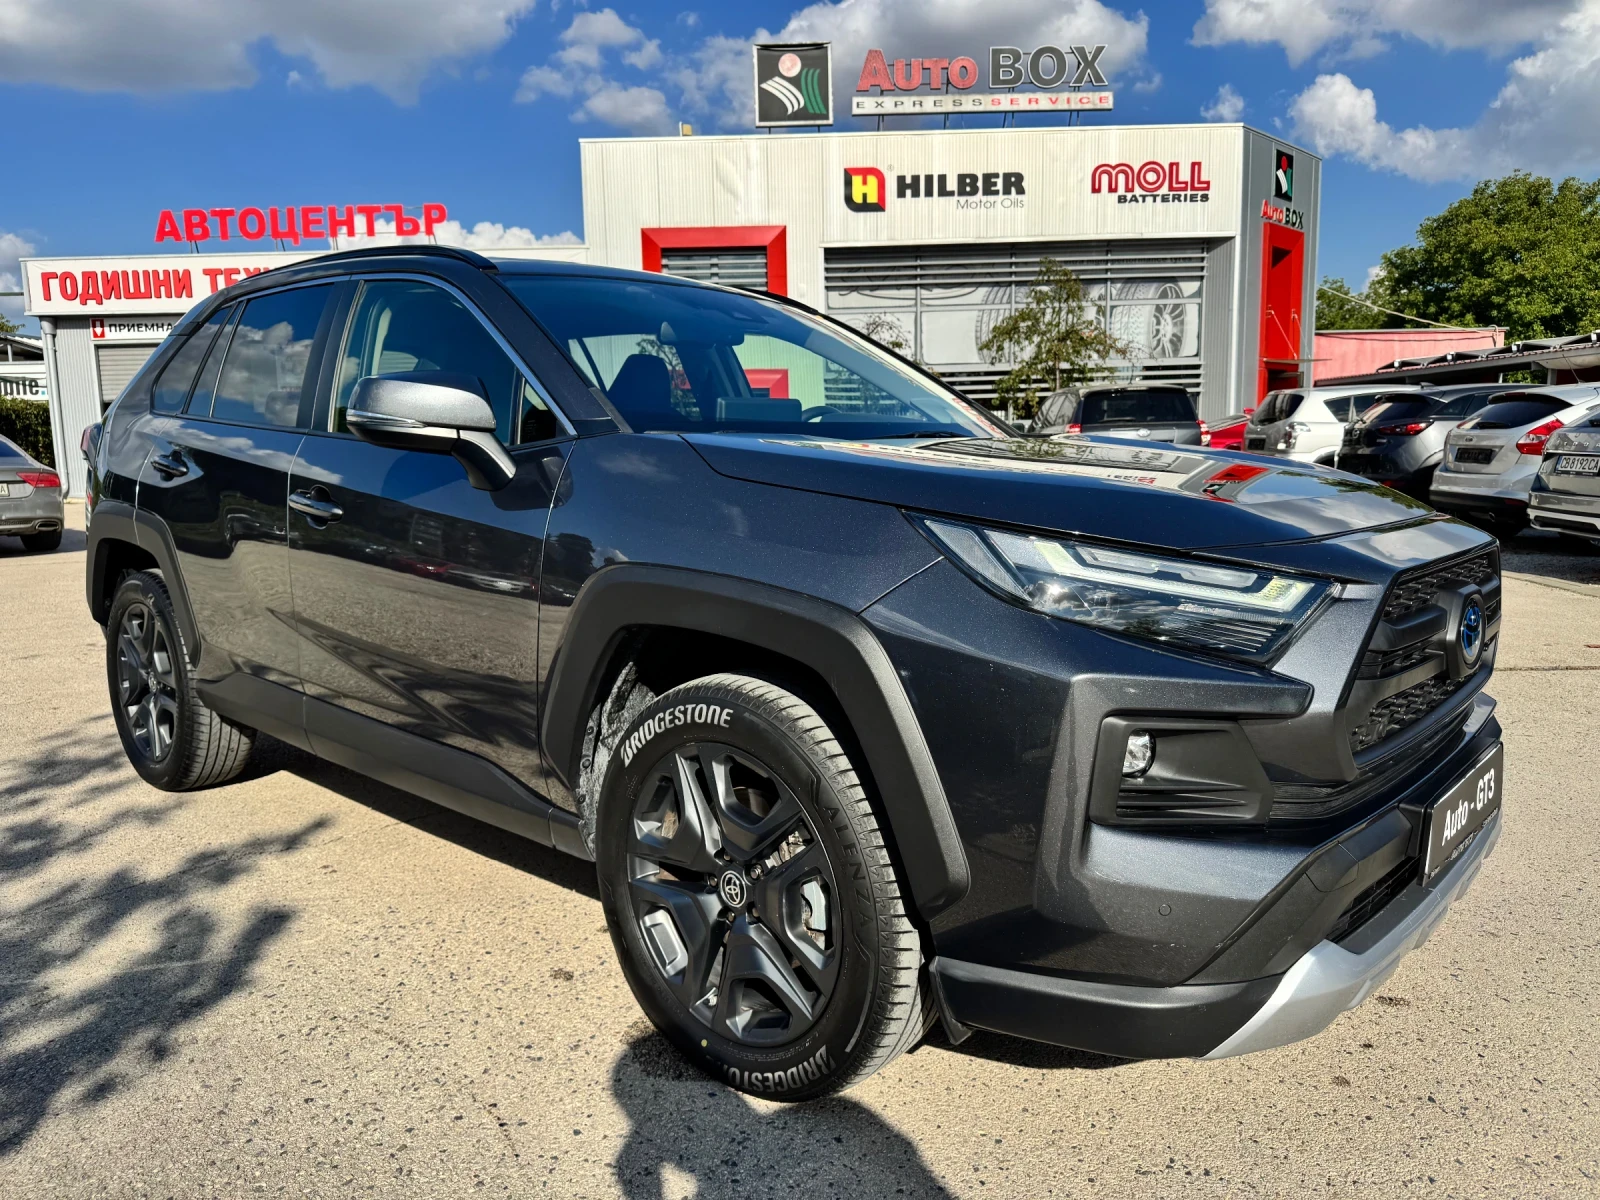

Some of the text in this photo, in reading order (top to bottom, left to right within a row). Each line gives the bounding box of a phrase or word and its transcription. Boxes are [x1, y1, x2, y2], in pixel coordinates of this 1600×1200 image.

[989, 44, 1108, 89] BOX
[856, 94, 1110, 109] EXPRESS SERVICE
[896, 172, 1026, 199] HILBER
[956, 198, 1025, 210] Motor Oils
[1117, 193, 1210, 204] BATTERIES
[154, 203, 448, 246] АВТОЦЕНТЪР
[1284, 207, 1304, 229] BOX
[41, 267, 270, 305] ГОДИШНИ ТЕ
[620, 703, 734, 768] BRIDGESTONE
[1441, 799, 1468, 847] Auto
[1476, 768, 1495, 811] GT3
[822, 806, 874, 928] ALENZA
[706, 1044, 837, 1093] BRIDGESTO
